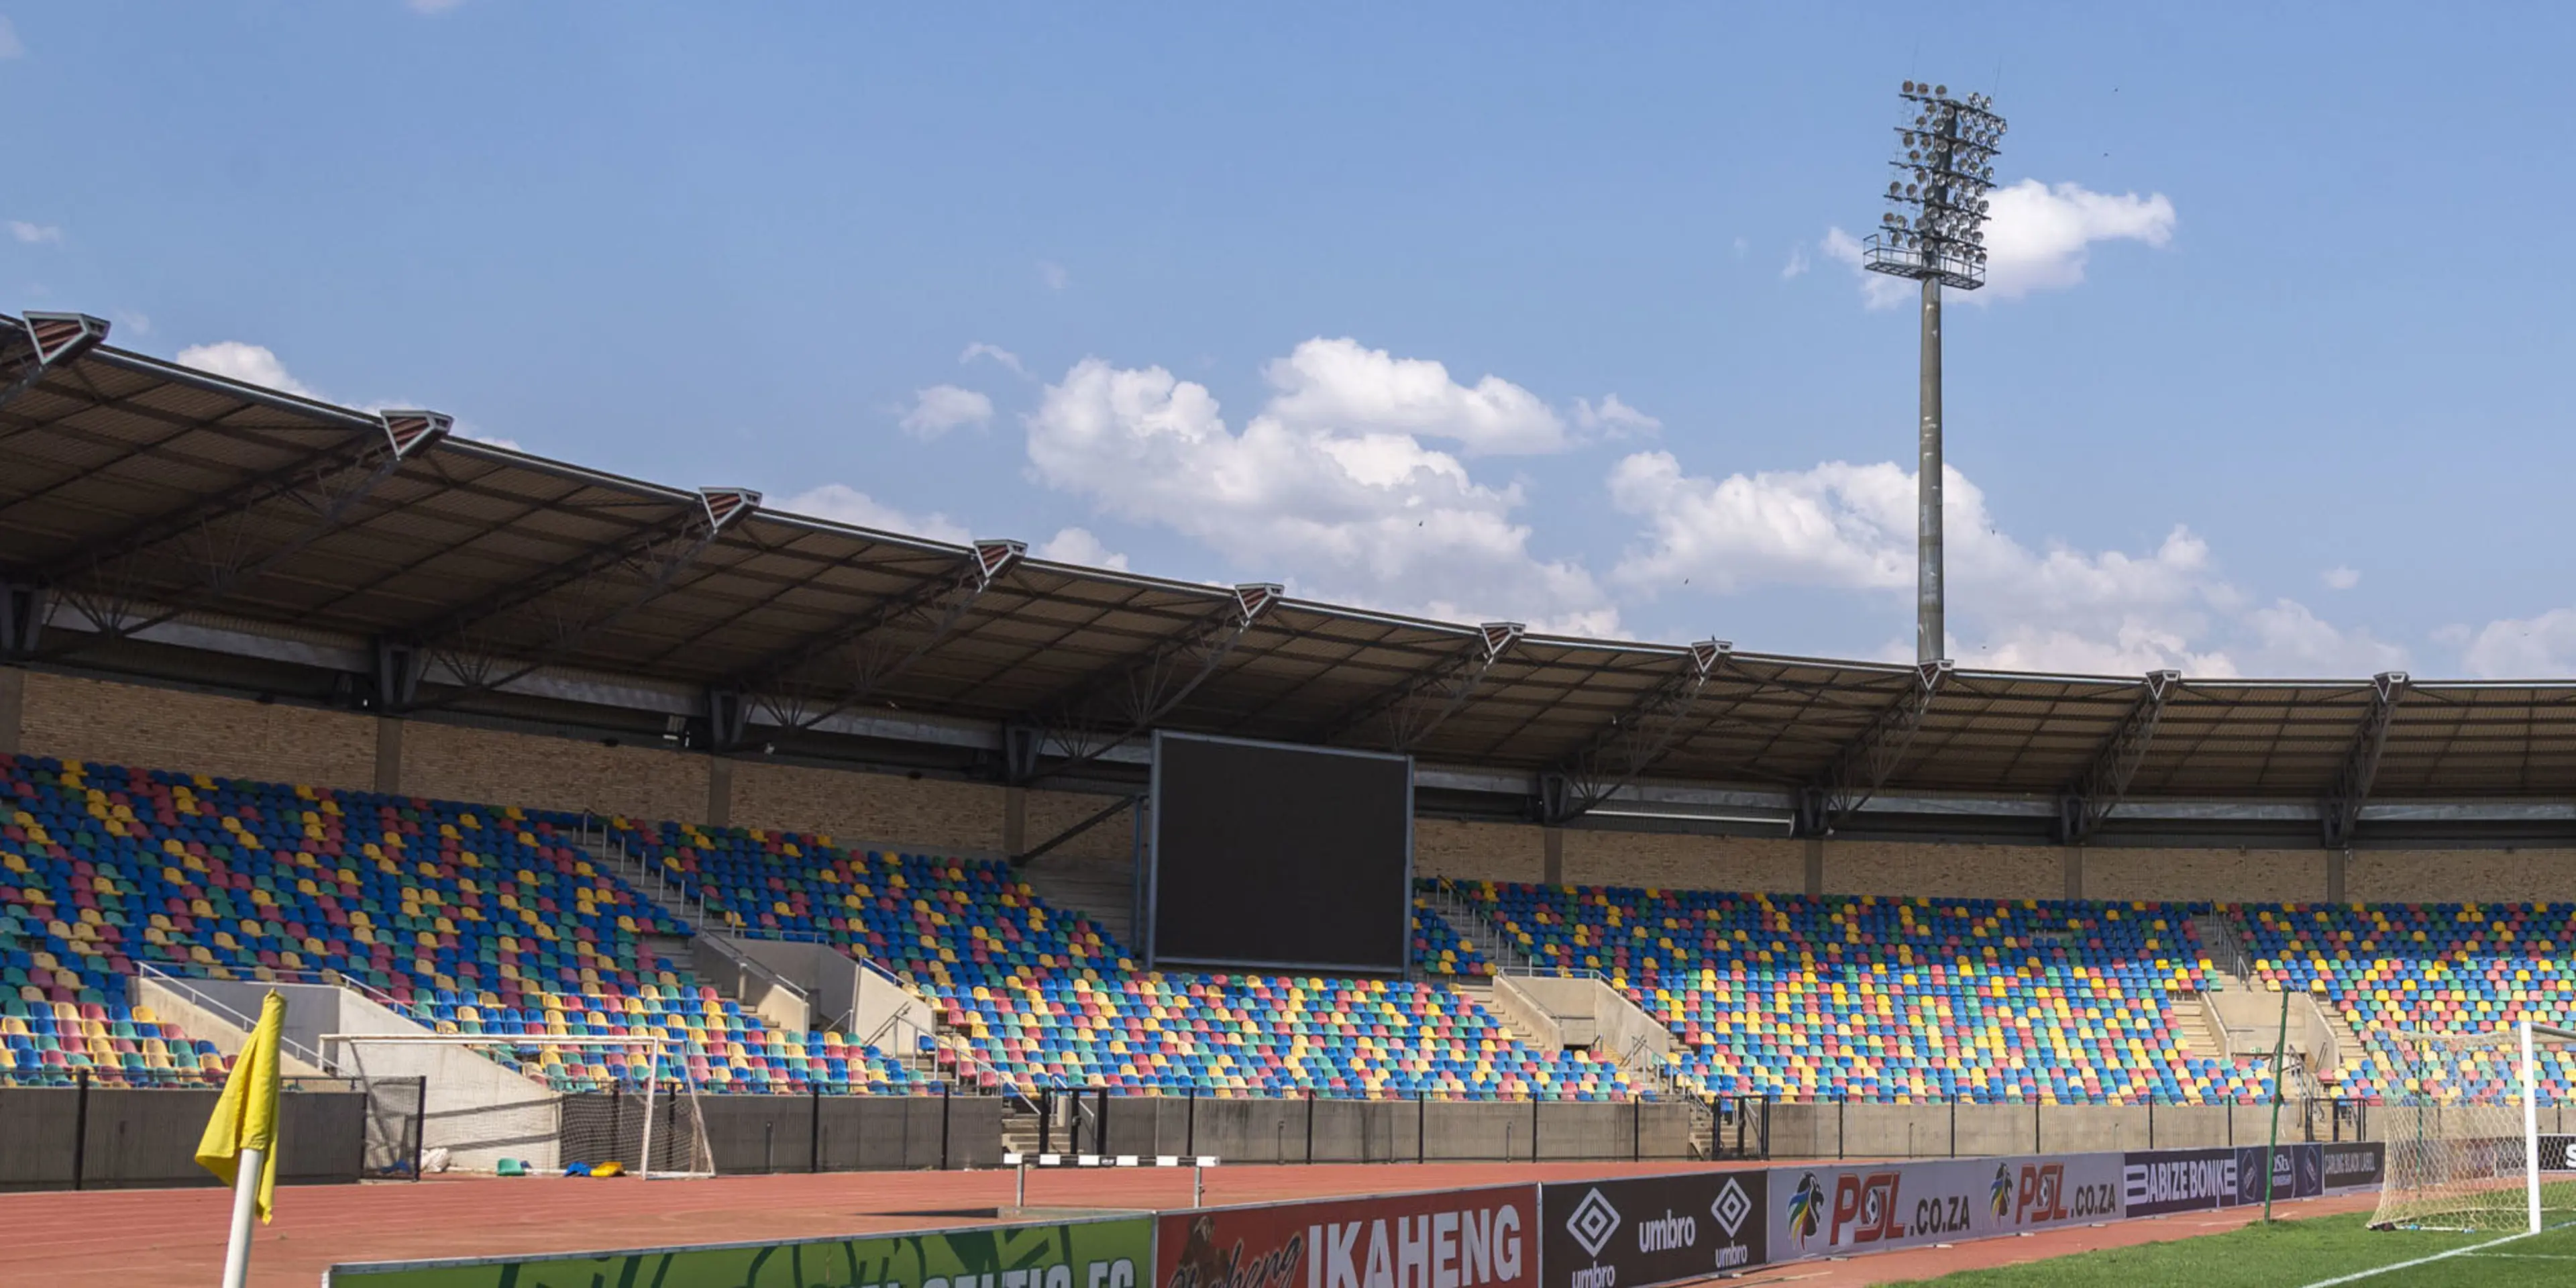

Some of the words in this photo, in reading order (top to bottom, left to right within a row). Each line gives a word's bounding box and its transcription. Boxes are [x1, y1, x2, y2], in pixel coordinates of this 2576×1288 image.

[2124, 1161, 2188, 1205] BABIZE
[2190, 1159, 2237, 1208] BONKE
[1308, 1205, 1521, 1288] IKAHENG
[1639, 1209, 1696, 1253] umbro
[1572, 1260, 1615, 1288] umbro
[1715, 1242, 1748, 1268] umbro
